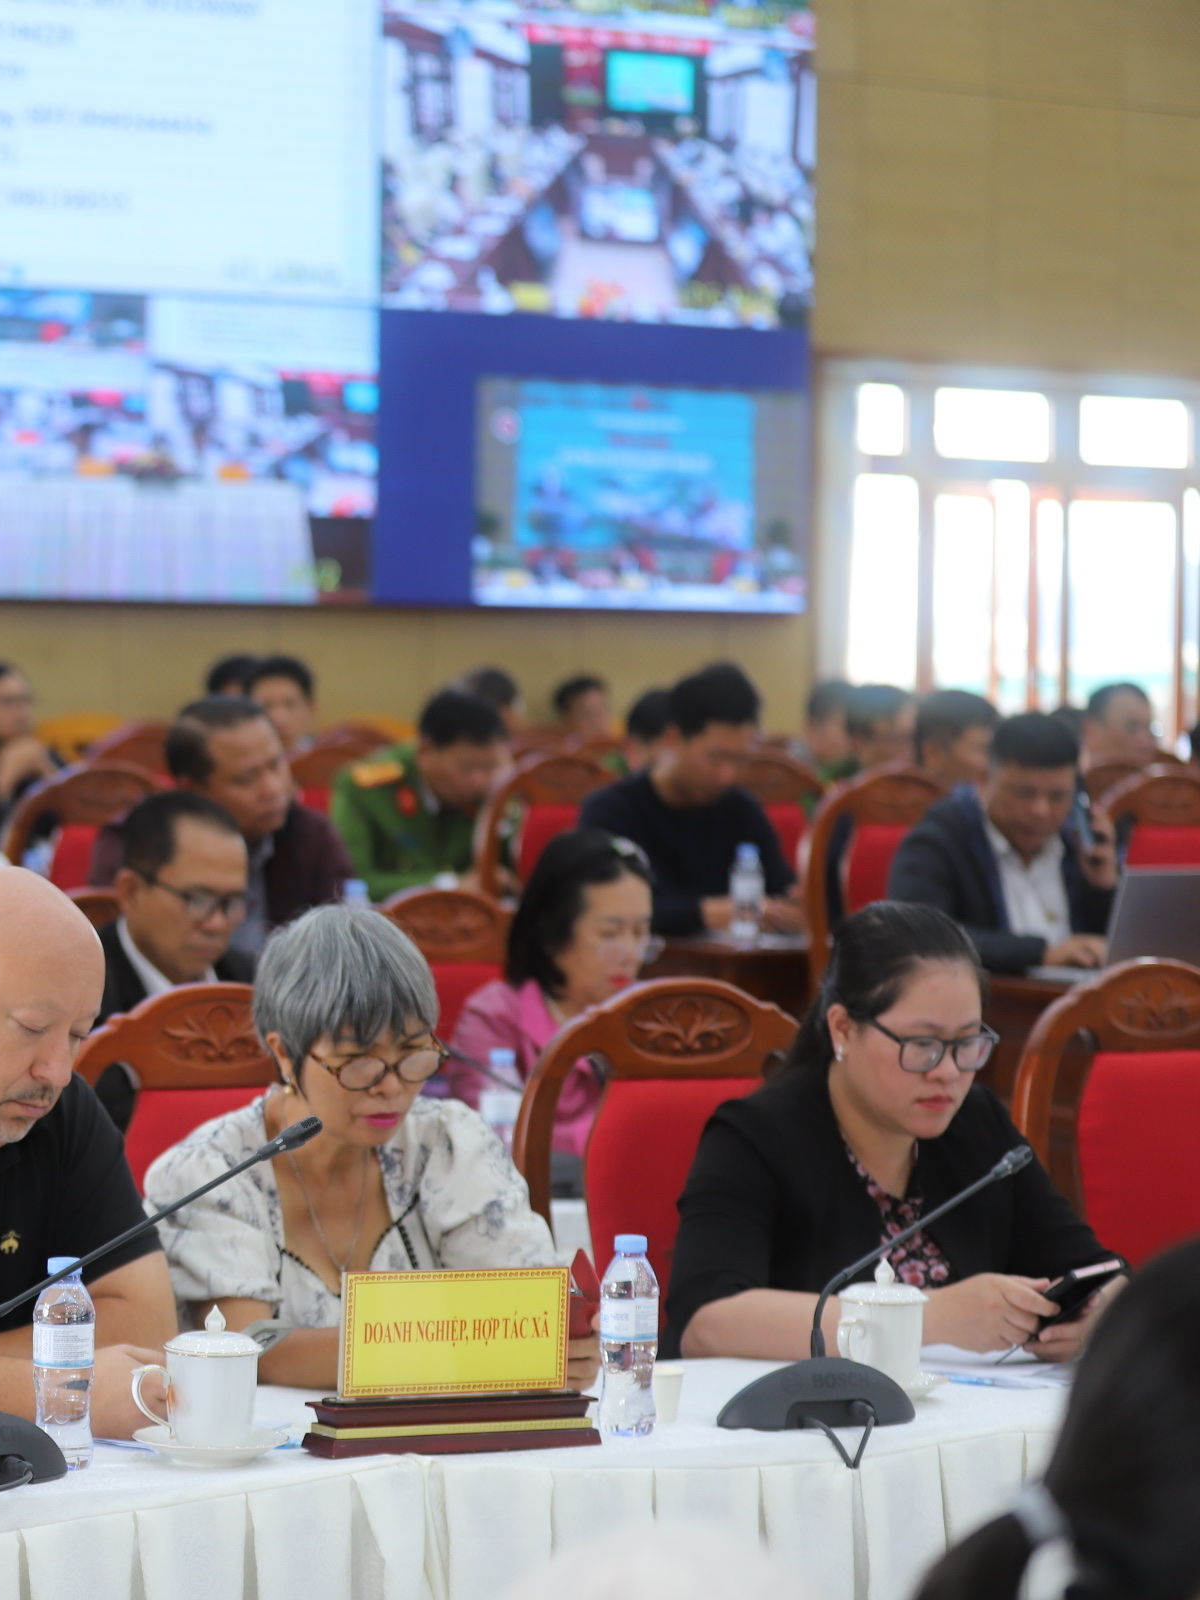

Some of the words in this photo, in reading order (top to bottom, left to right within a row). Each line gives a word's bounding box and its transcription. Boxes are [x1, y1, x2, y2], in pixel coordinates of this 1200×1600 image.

[364, 1320, 412, 1345] DOANH
[416, 1316, 469, 1347] NGHIỆP,
[472, 1316, 500, 1347] HỢP
[503, 1310, 529, 1340] TÁC
[532, 1310, 550, 1339] XÃ
[811, 1371, 870, 1390] BOSCH
